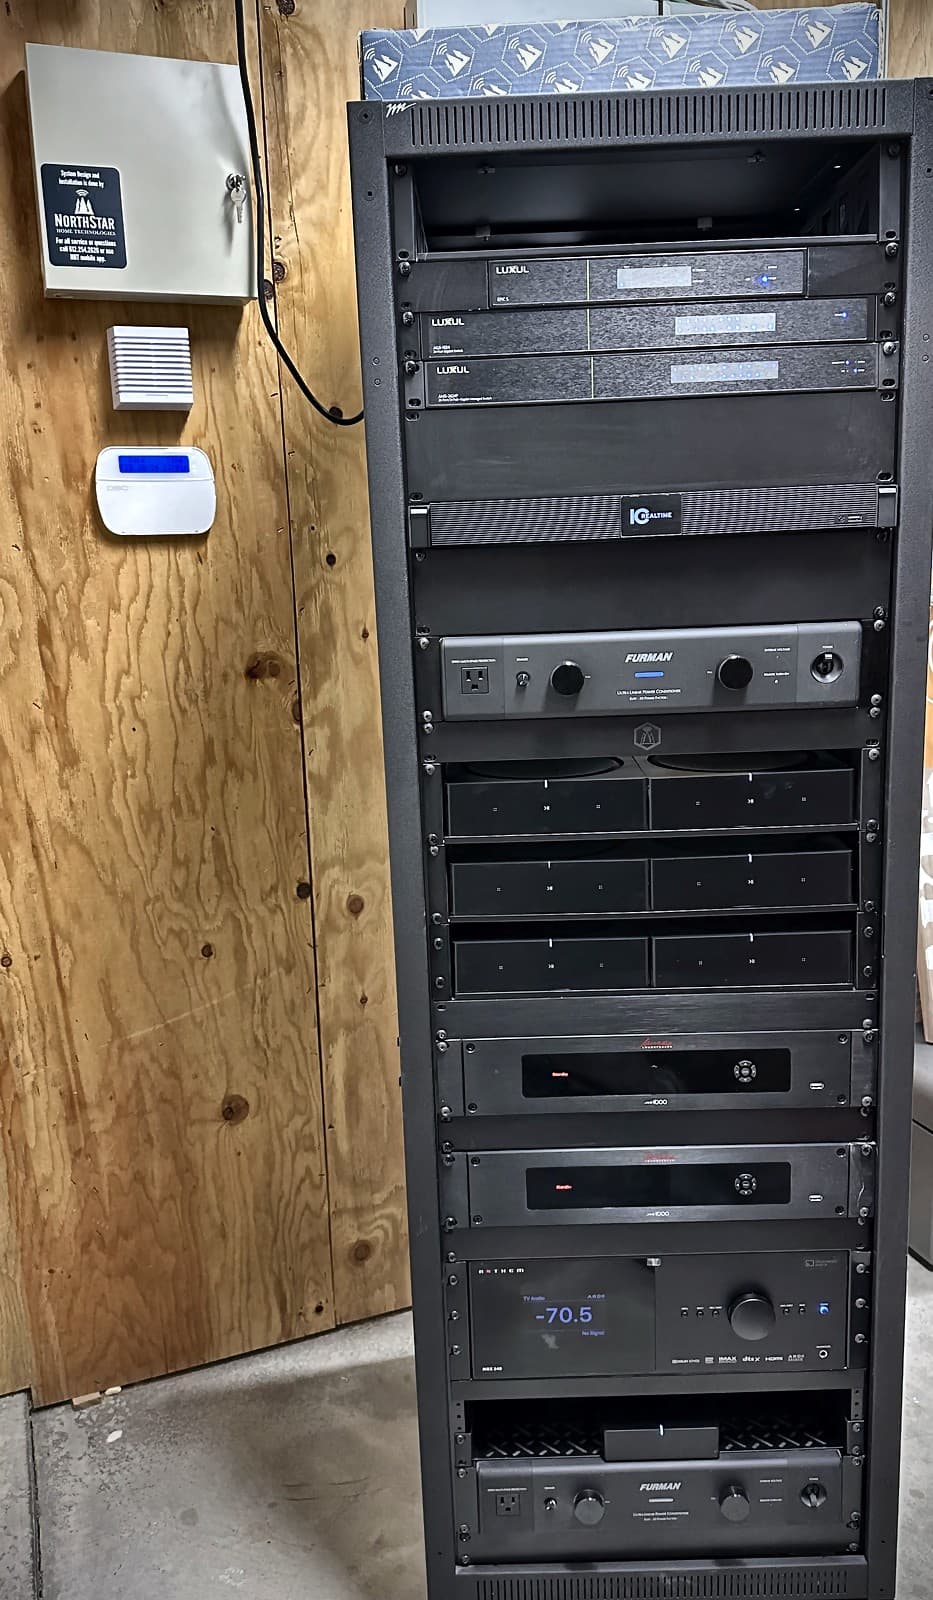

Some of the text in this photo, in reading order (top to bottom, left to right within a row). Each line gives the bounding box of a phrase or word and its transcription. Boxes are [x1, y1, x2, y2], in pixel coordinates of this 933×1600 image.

[55, 213, 115, 230] NORTHSTAR
[496, 265, 530, 275] LUXUL
[432, 318, 465, 326] LUXUL
[437, 366, 470, 375] LUXUL
[625, 652, 673, 663] FURMAN
[536, 1306, 593, 1324] -70.5
[640, 1482, 681, 1491] FURMAN
